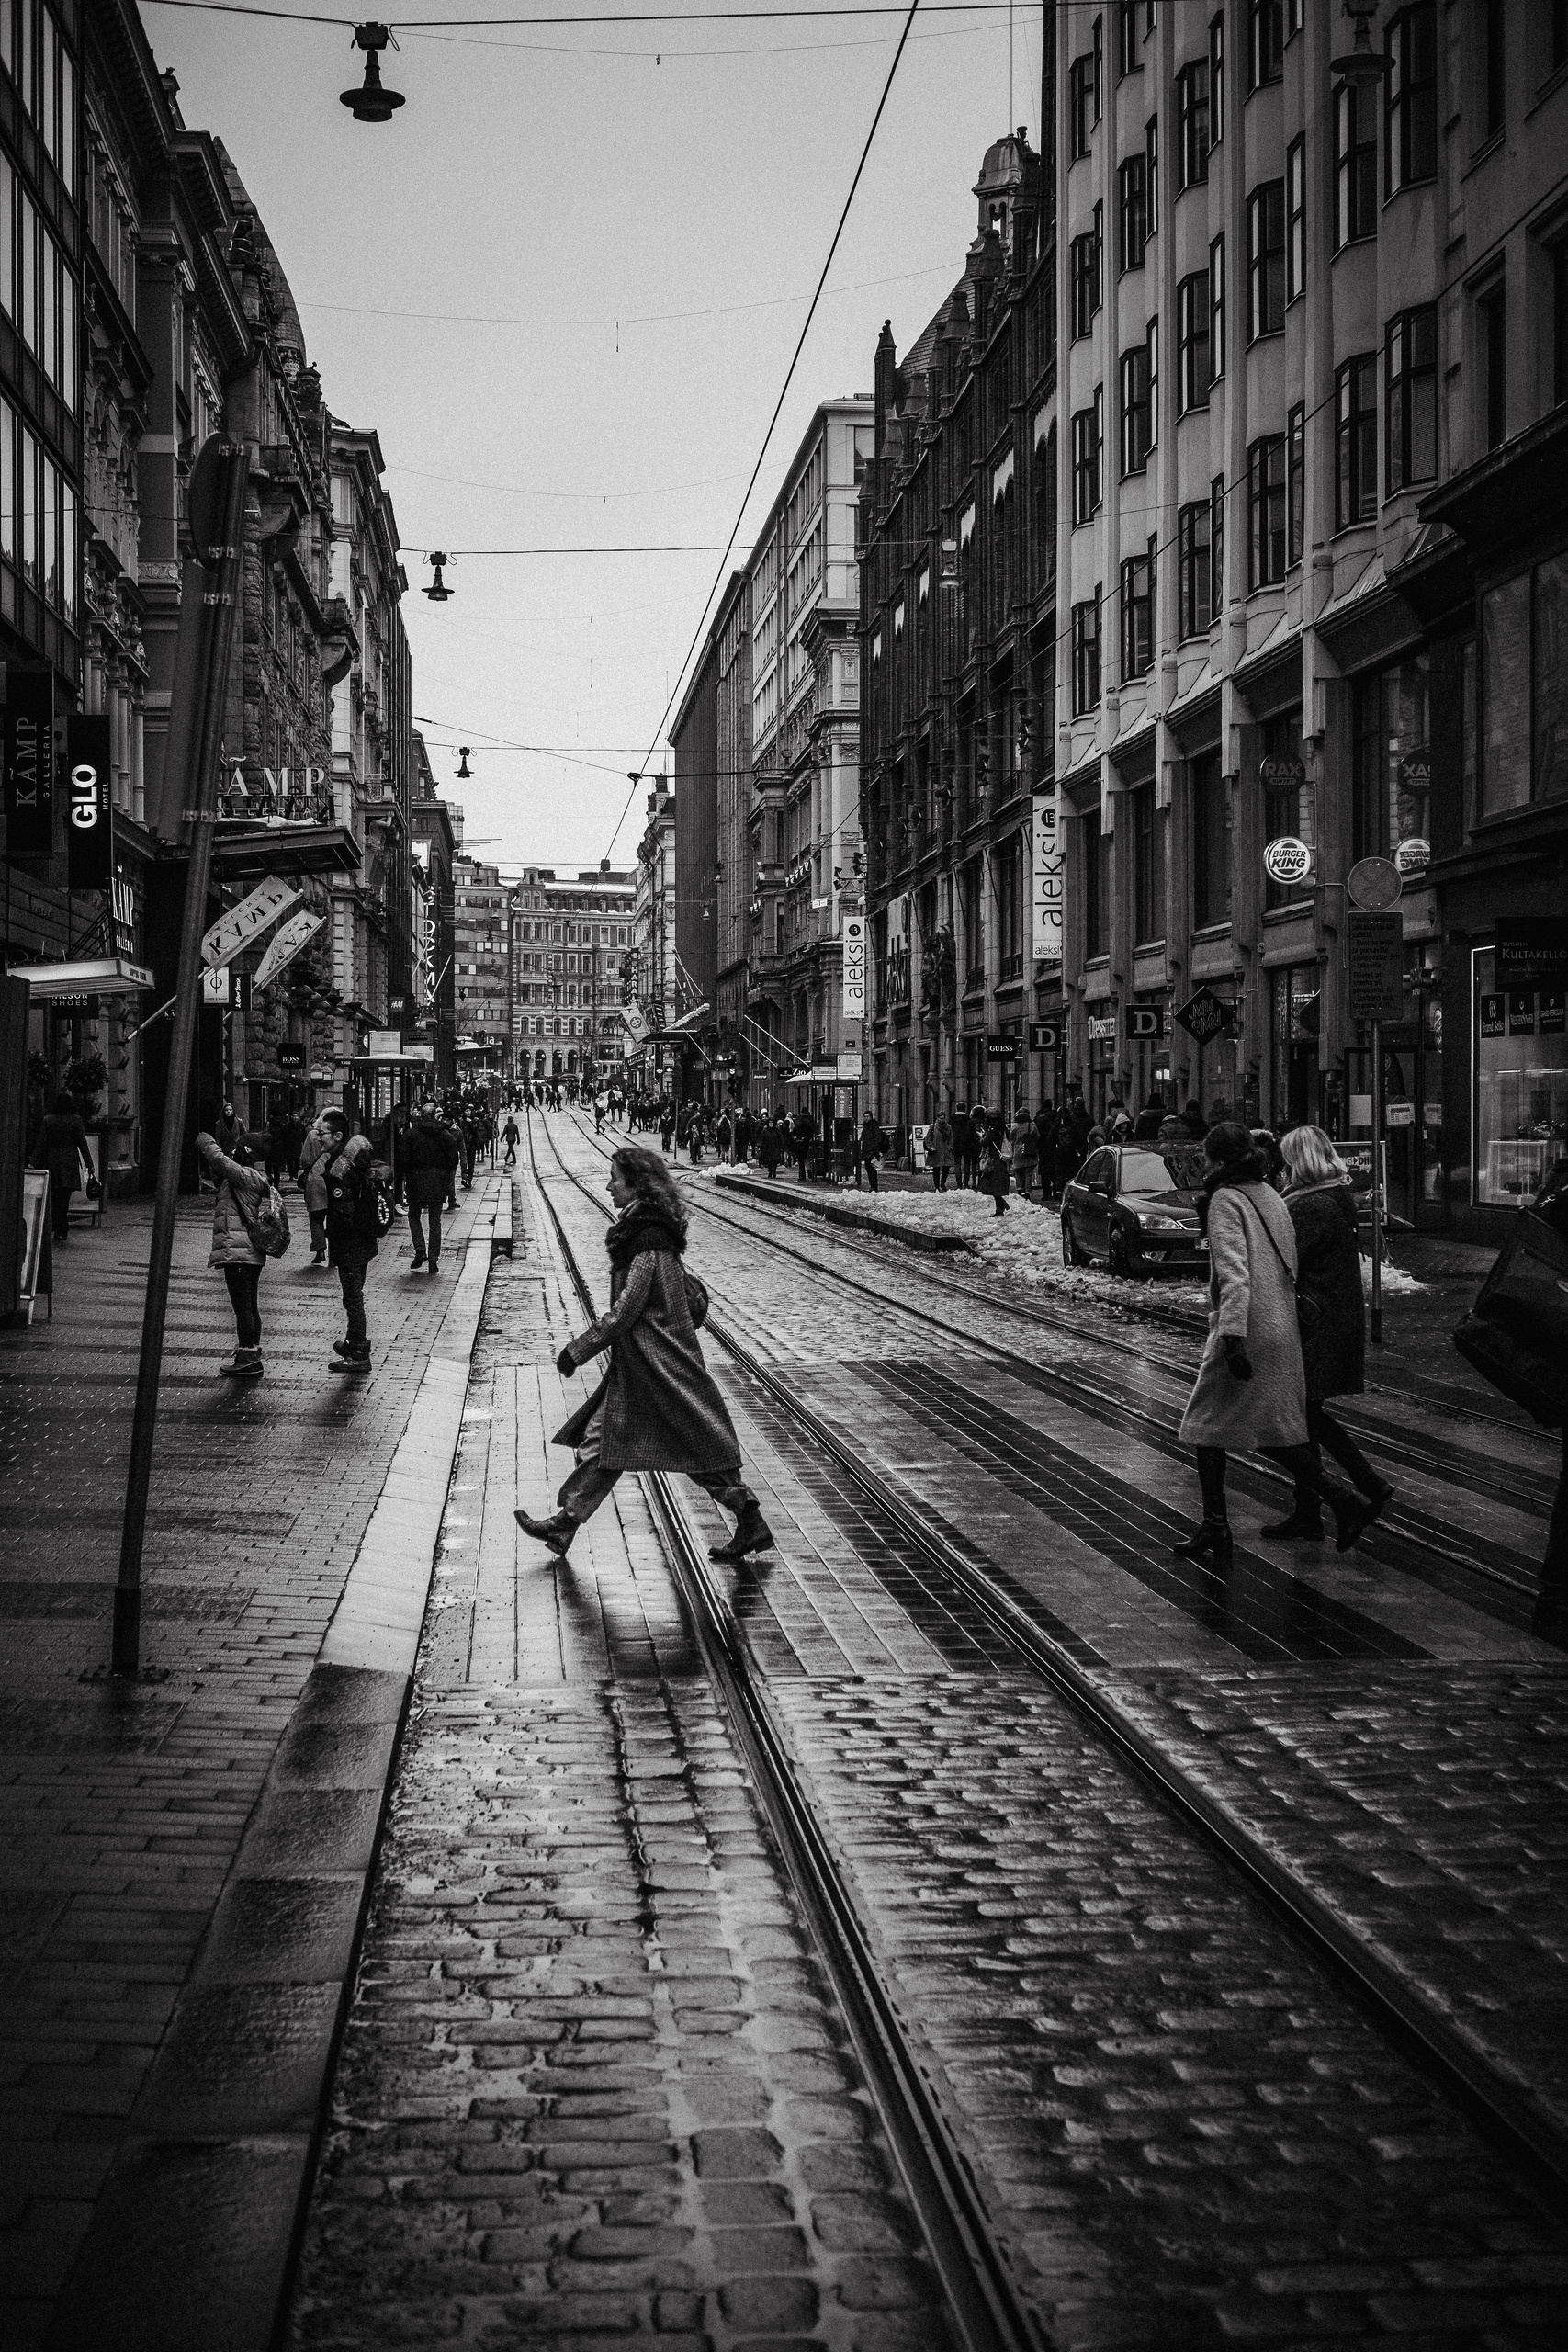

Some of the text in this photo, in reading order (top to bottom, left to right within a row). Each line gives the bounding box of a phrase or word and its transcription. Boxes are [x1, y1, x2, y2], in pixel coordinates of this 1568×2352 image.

[42, 725, 51, 798] GALLERIA
[1264, 763, 1303, 778] RAX
[71, 764, 98, 829] GLO
[1272, 850, 1307, 859] BURGER
[1270, 857, 1307, 869] KING
[1034, 945, 1060, 955] aleksi
[844, 926, 863, 999] aleksi 13
